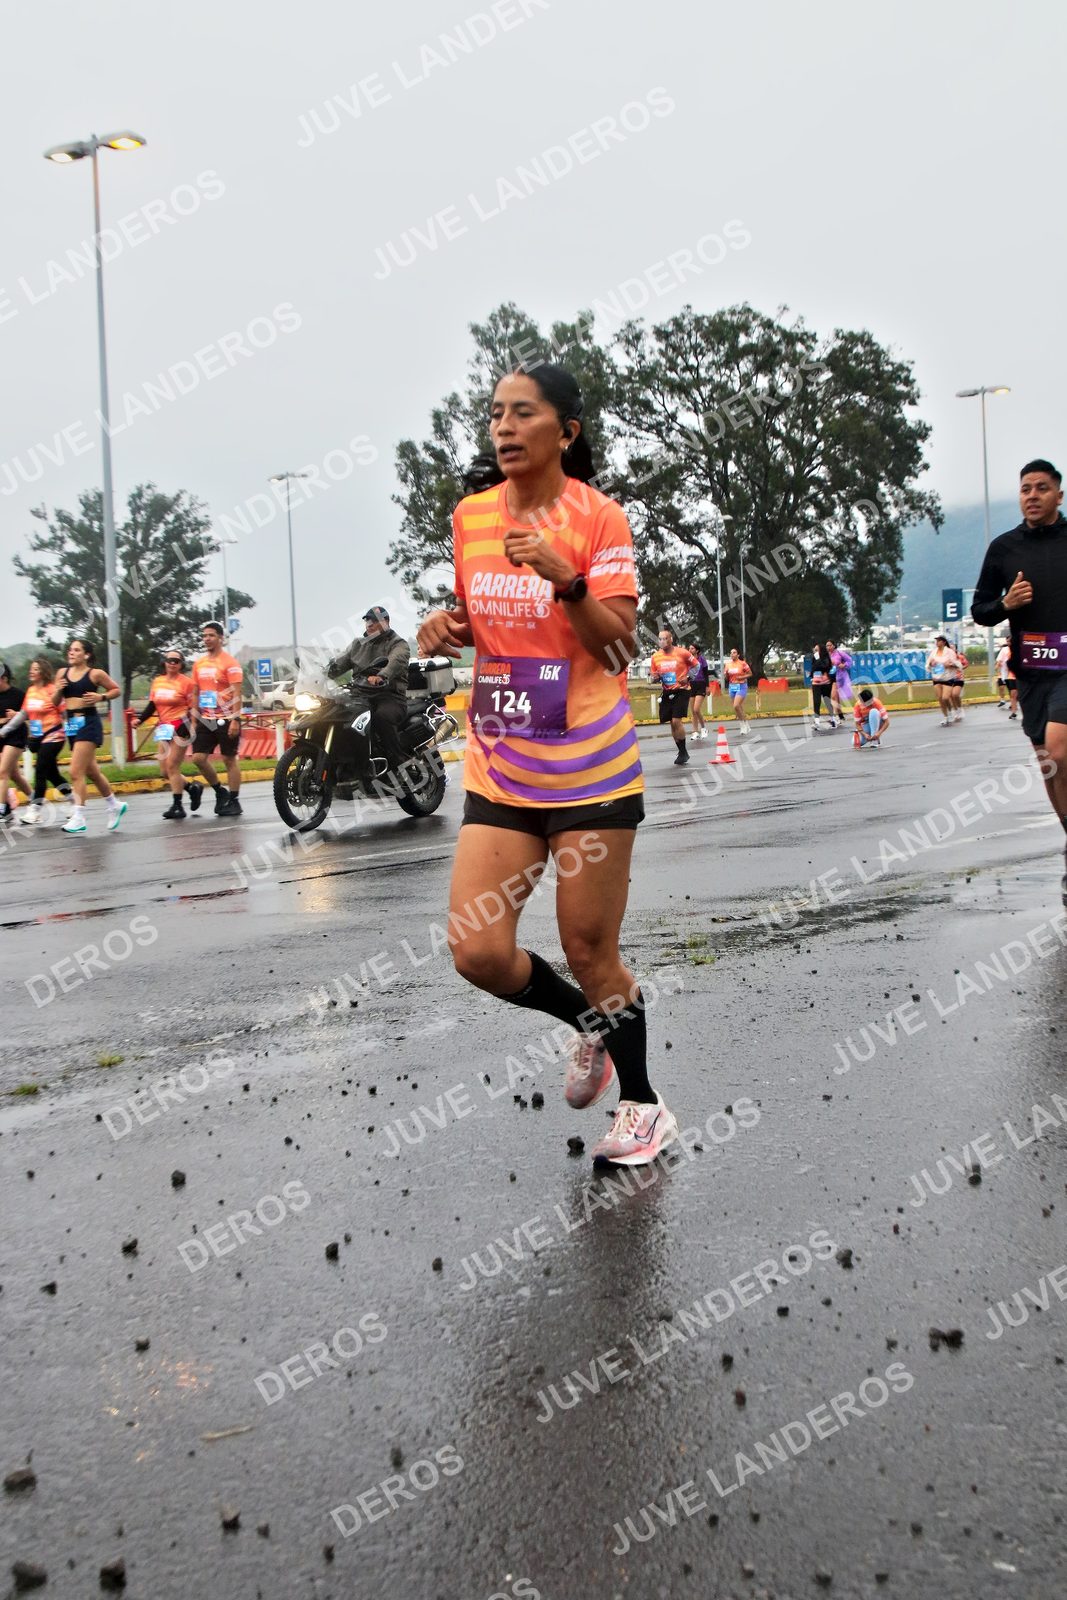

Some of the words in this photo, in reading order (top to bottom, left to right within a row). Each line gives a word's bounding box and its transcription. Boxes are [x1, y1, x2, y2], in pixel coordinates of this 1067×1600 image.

[470, 572, 552, 598] CARRERA
[470, 600, 532, 617] OMNILIFE
[946, 602, 958, 618] E
[1032, 647, 1059, 659] 370
[539, 664, 562, 680] 15K
[491, 690, 531, 714] 124
